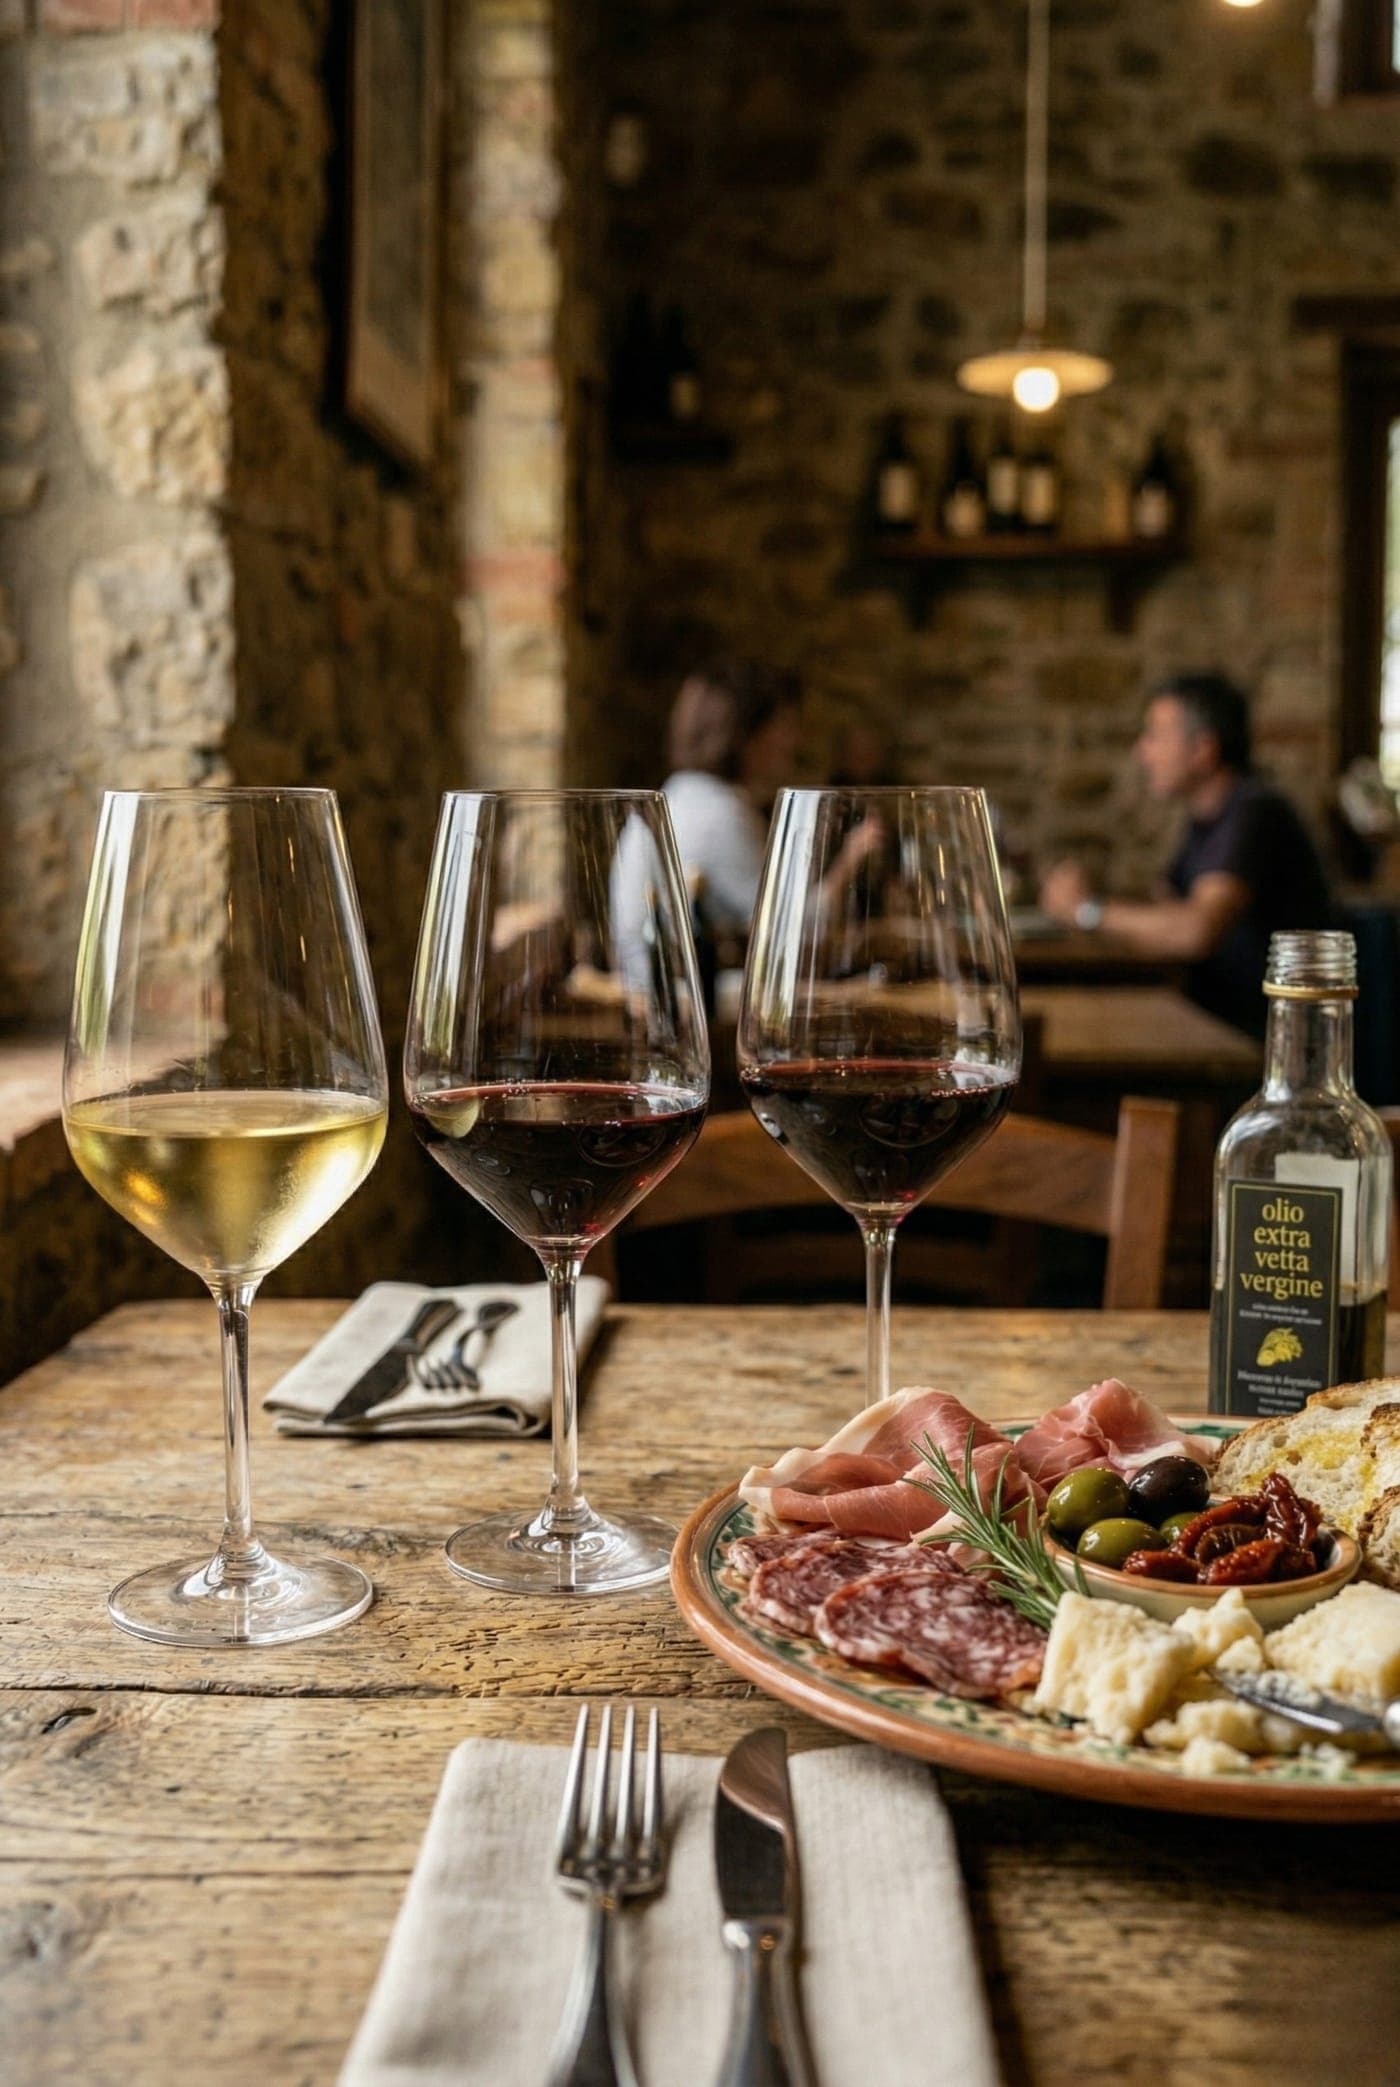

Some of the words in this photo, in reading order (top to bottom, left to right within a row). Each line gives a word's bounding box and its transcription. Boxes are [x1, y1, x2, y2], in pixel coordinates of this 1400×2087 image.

[1262, 1198, 1304, 1222] olio
[1254, 1226, 1311, 1248] extra
[1255, 1250, 1310, 1272] vetta
[1240, 1272, 1324, 1300] vergine
